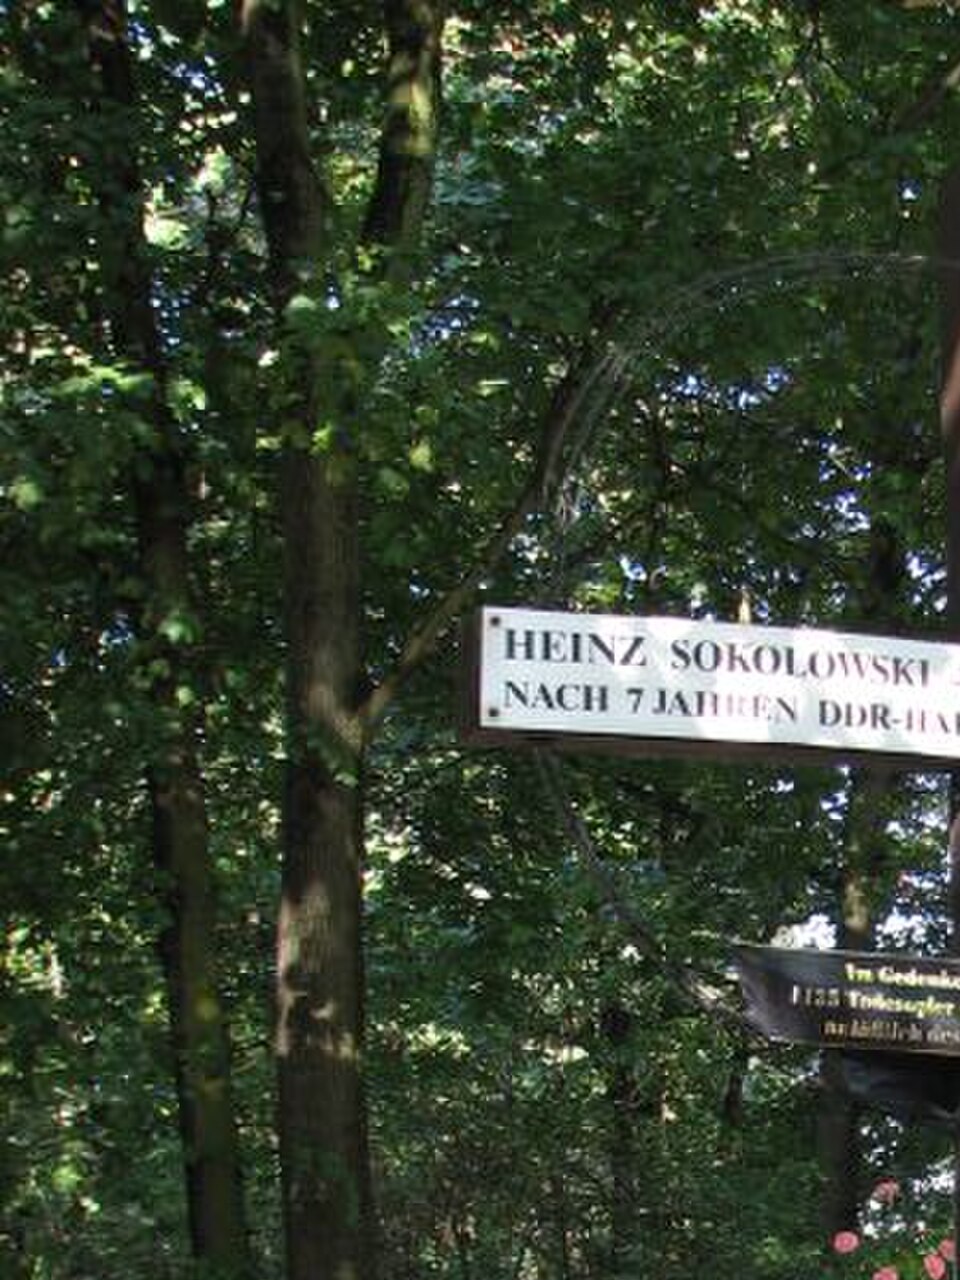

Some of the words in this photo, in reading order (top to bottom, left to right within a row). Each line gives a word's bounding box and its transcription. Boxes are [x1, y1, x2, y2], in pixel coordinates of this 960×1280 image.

[505, 628, 648, 667] HEINZ
[671, 640, 933, 688] SOKOLOWSKI
[504, 680, 609, 713] NACH
[627, 687, 642, 715] 7
[651, 689, 798, 727] JAHREN
